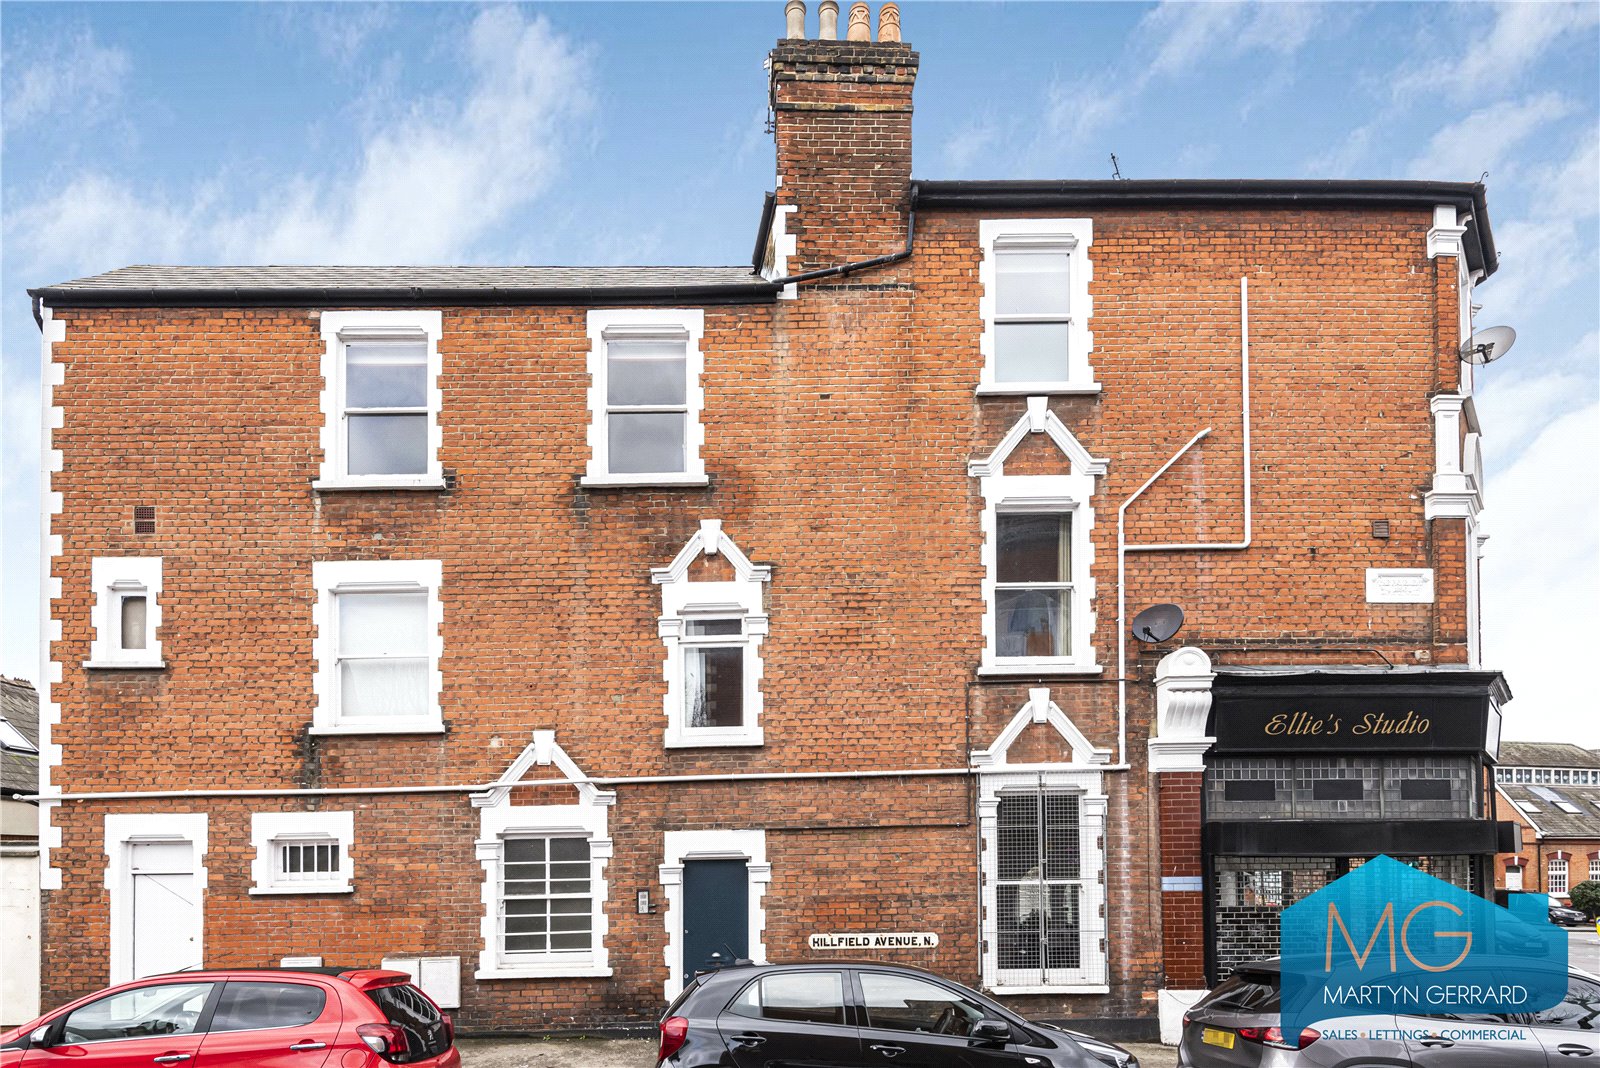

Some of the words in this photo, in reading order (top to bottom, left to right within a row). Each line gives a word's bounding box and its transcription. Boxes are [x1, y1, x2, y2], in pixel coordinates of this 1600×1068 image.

[1264, 711, 1342, 735] Ellie's
[1352, 710, 1430, 735] Studio
[812, 937, 870, 947] HILLFIELD
[874, 936, 922, 947] AVENUE,
[923, 936, 935, 946] N.
